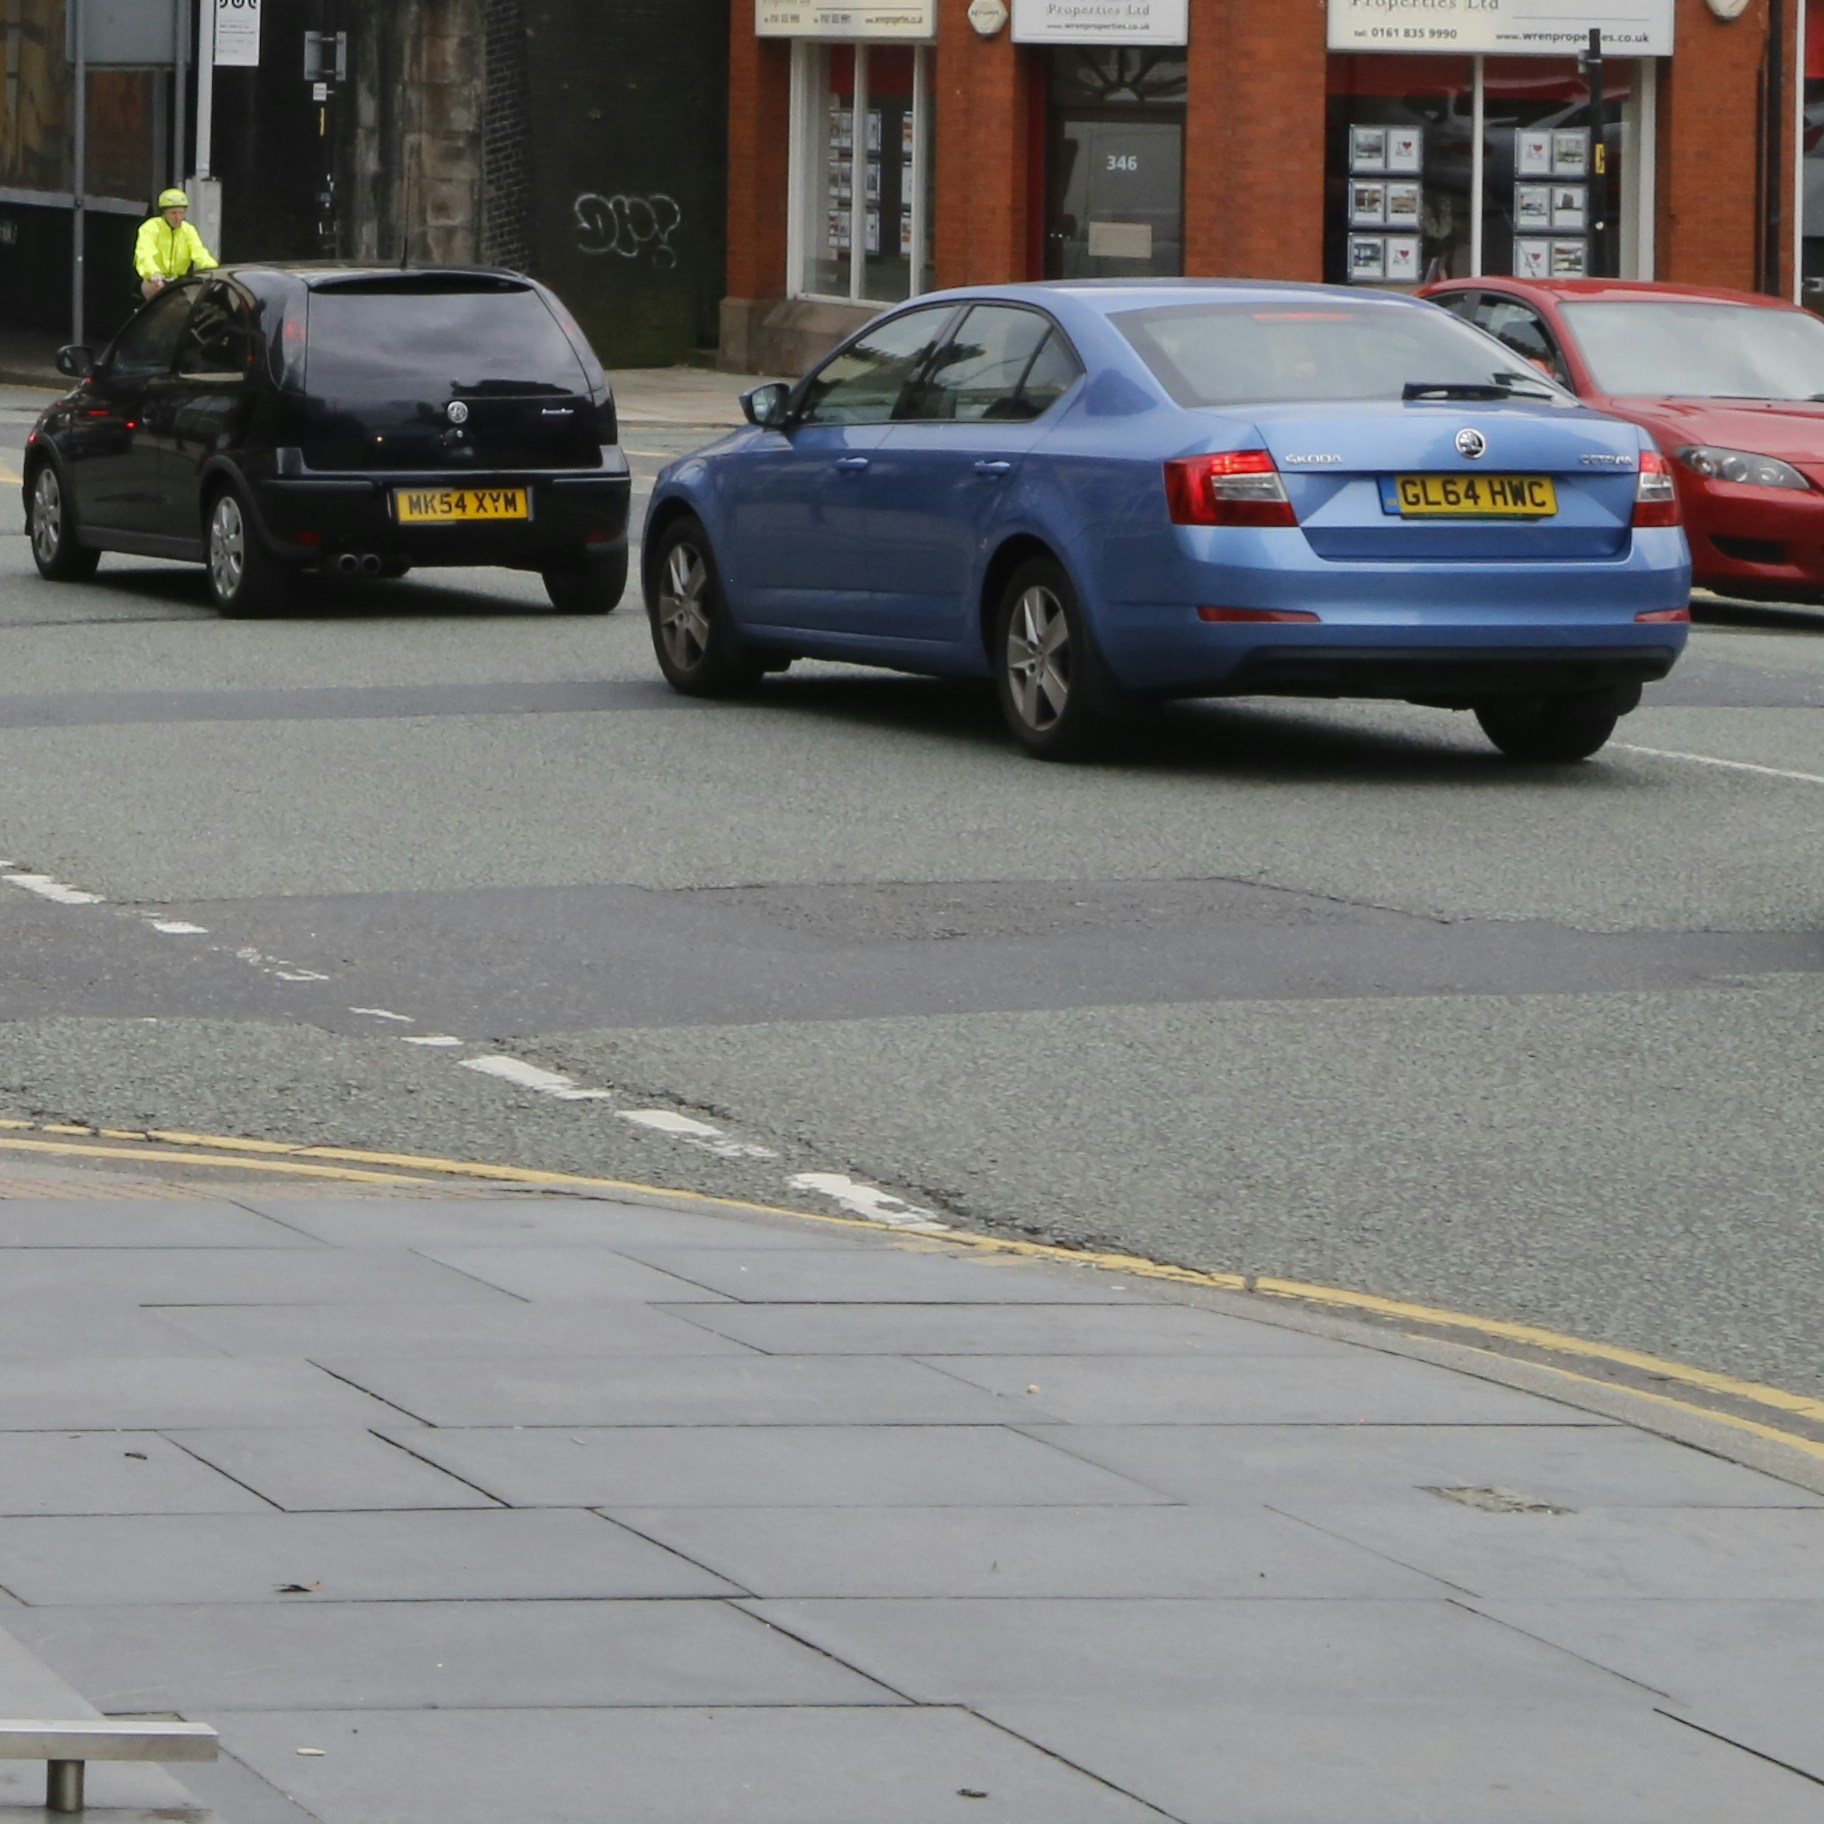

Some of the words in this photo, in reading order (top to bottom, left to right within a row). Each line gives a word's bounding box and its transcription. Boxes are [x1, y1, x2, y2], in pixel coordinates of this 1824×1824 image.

[1047, 3, 1120, 18] Properties
[1127, 4, 1150, 16] Ltd
[1371, 26, 1399, 39] 0161
[1403, 27, 1425, 39] 835
[1428, 28, 1457, 40] 9990
[1495, 29, 1650, 45] www.wrenpropees.co.uk
[1106, 154, 1138, 171] 346
[1401, 479, 1481, 507] GL64
[1490, 478, 1547, 508] HWC
[408, 494, 468, 516] MK54
[472, 491, 519, 513] XYM
